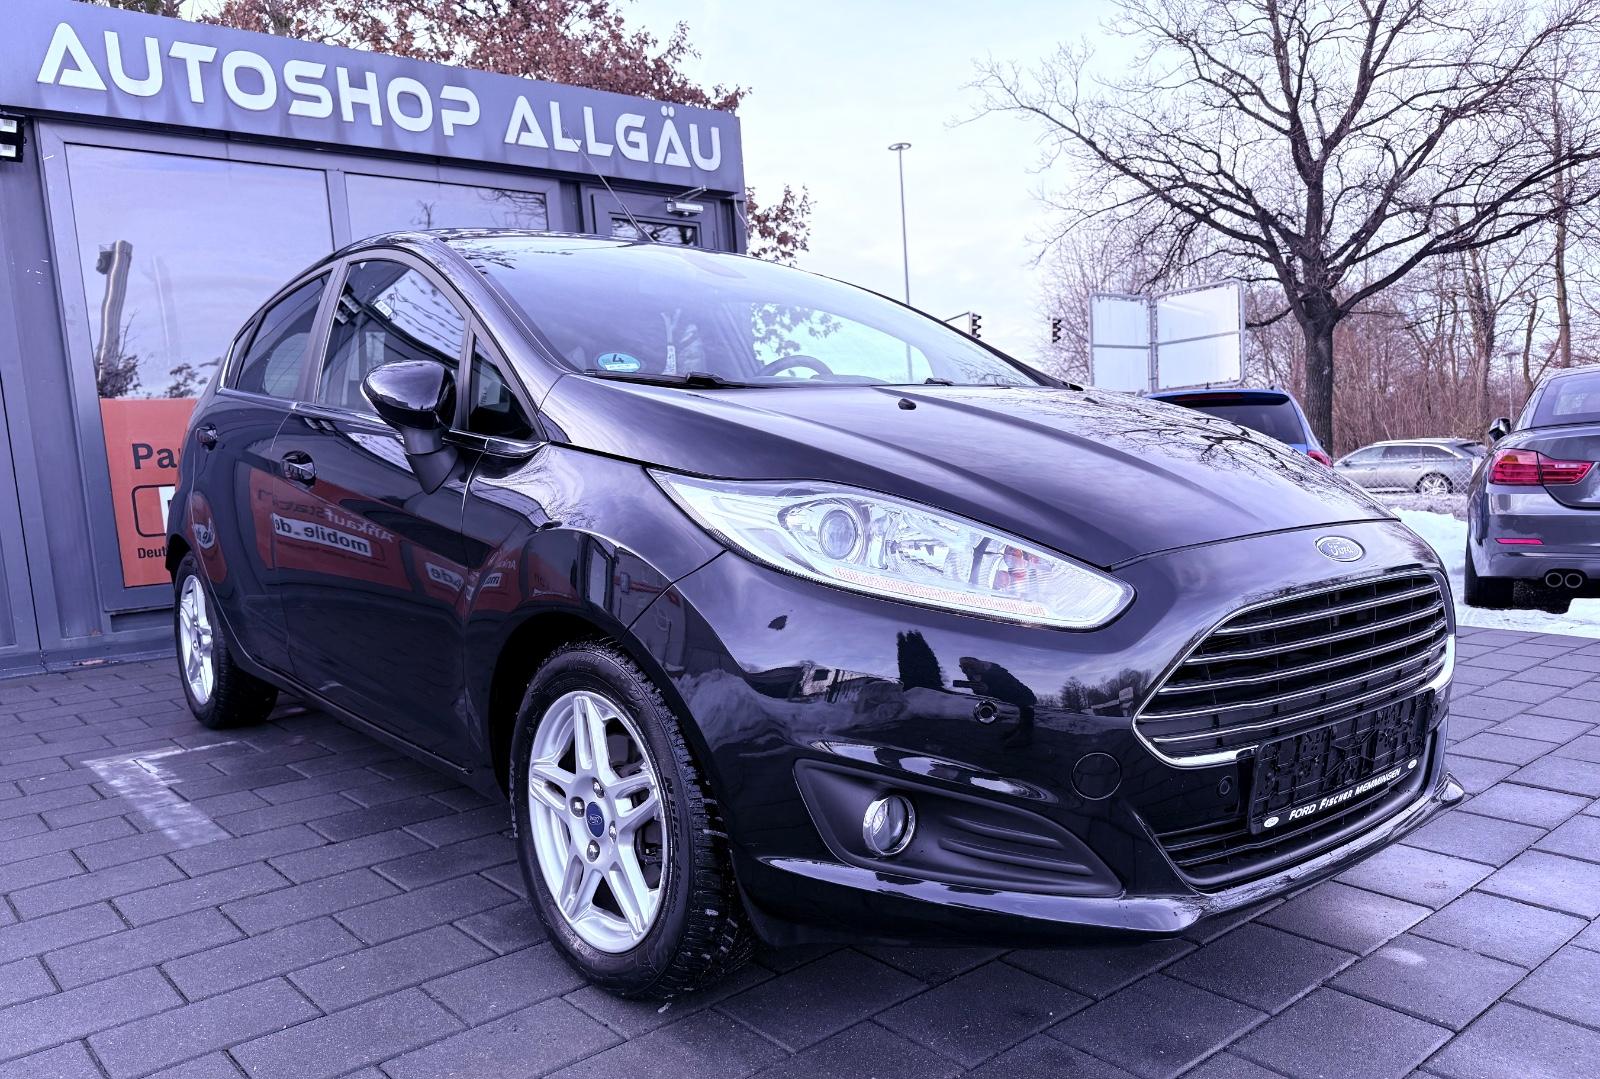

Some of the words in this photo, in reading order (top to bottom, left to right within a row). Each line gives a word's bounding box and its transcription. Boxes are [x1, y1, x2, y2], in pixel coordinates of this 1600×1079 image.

[37, 22, 481, 136] AUTOSHOP
[504, 95, 722, 172] ALLGÄU
[131, 443, 183, 470] Pa
[1288, 803, 1317, 820] FORD
[1354, 766, 1402, 796] MEMMINGEN
